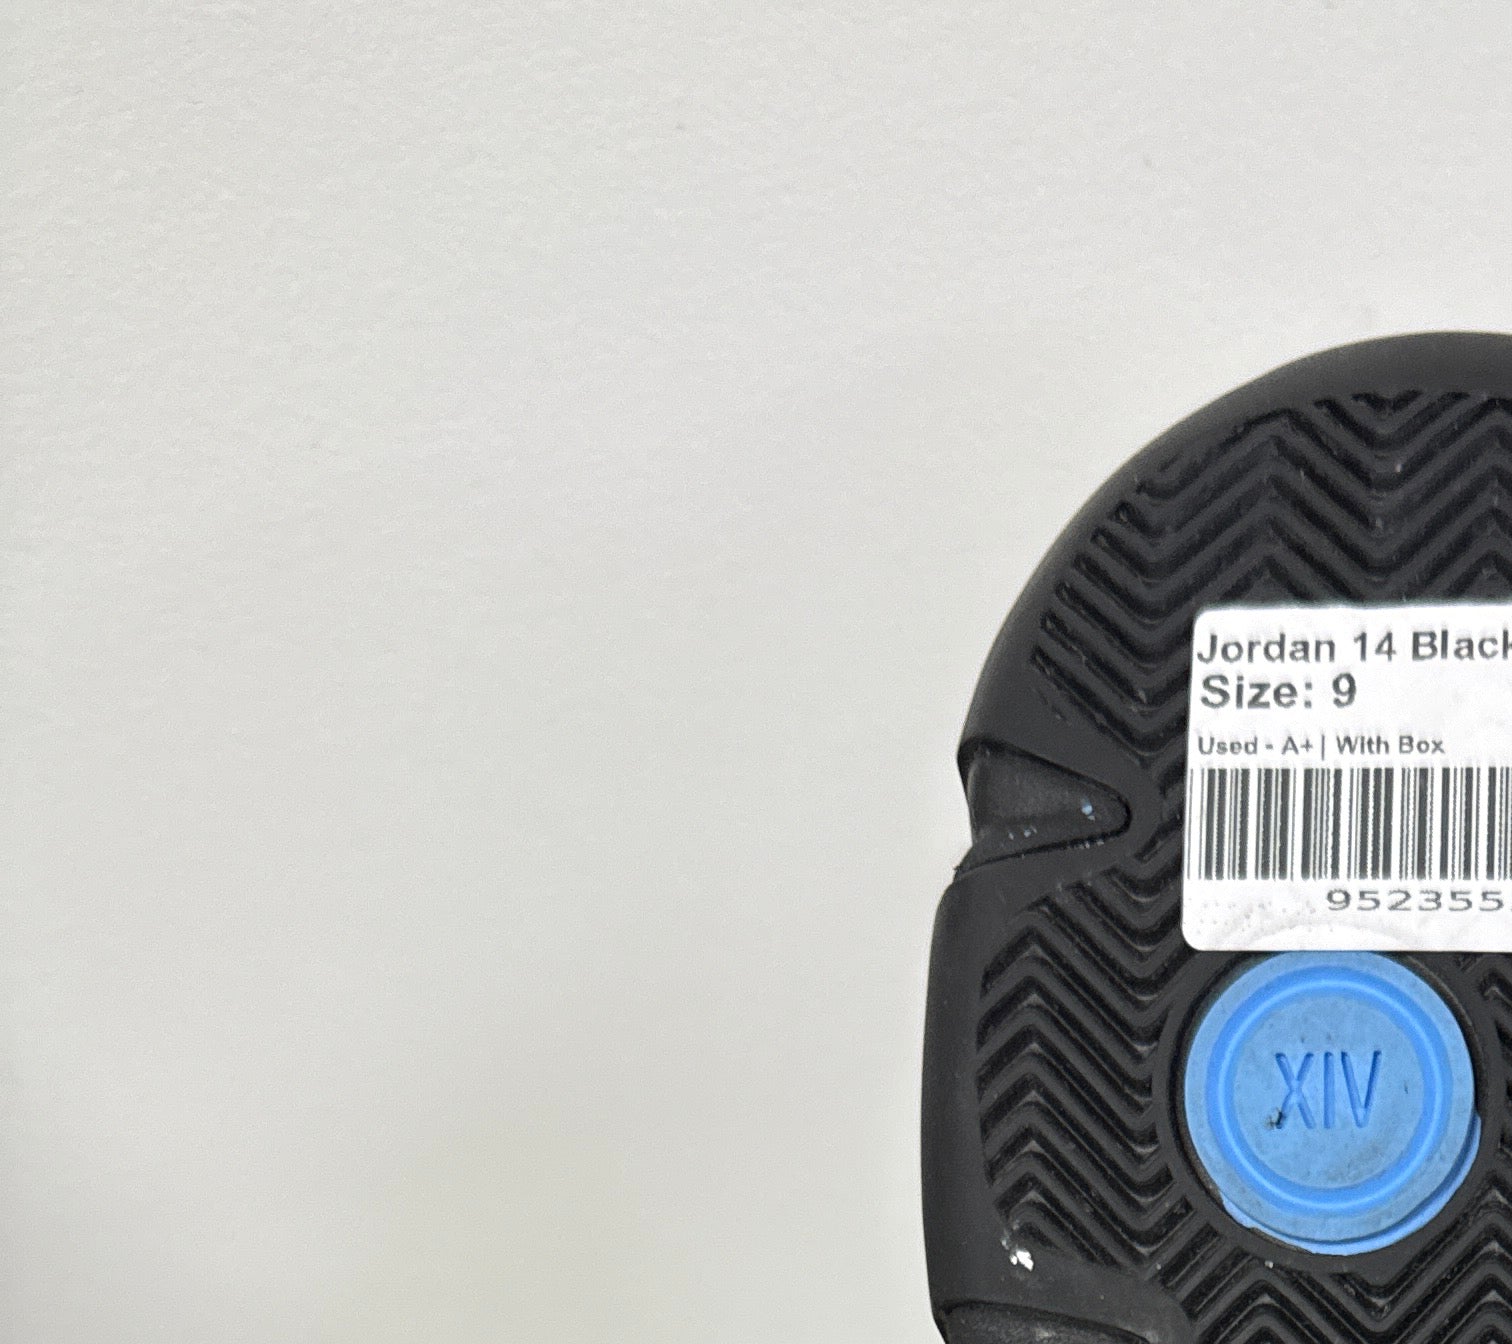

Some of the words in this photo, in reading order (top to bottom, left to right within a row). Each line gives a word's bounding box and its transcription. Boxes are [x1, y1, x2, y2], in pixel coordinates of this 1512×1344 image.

[1197, 631, 1336, 664] Jordan
[1353, 631, 1396, 660] 14
[1200, 673, 1314, 709] Size:
[1332, 672, 1357, 707] 9
[1198, 735, 1258, 756] Used
[1336, 734, 1389, 755] With
[1398, 734, 1446, 754] Box
[1274, 1051, 1382, 1129] XIV
